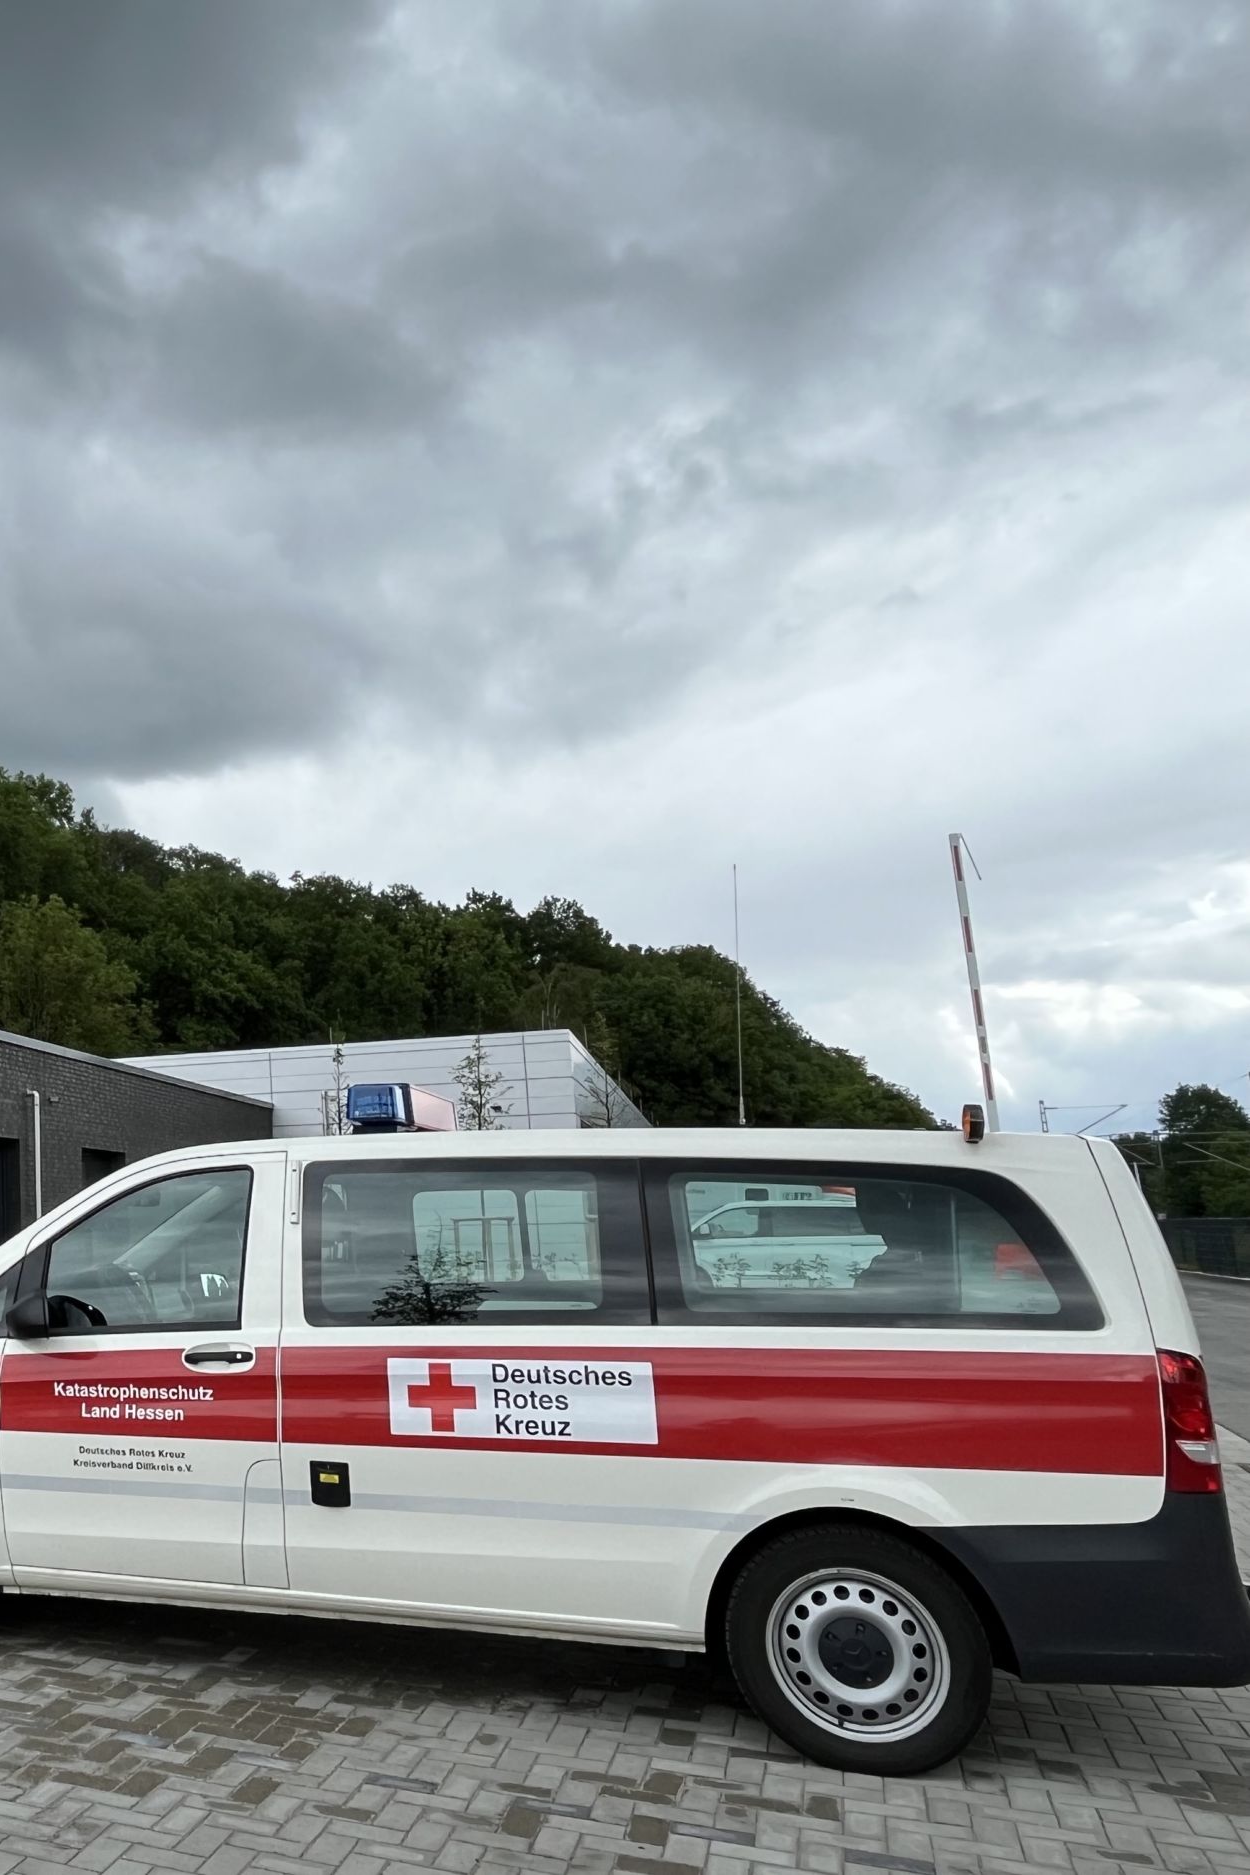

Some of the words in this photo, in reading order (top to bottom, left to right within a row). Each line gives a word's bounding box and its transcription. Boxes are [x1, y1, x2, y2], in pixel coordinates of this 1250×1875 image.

[491, 1363, 632, 1386] Deutsches
[53, 1381, 214, 1402] Katastrophenschutz
[493, 1388, 569, 1411] Rotes
[81, 1403, 120, 1419] Land
[125, 1404, 184, 1421] Hessen
[495, 1414, 572, 1437] Kreuz
[78, 1445, 127, 1457] Deutsches
[129, 1448, 156, 1458] Rotes
[158, 1449, 186, 1460] Kreuz
[73, 1458, 134, 1470] Kreisverband
